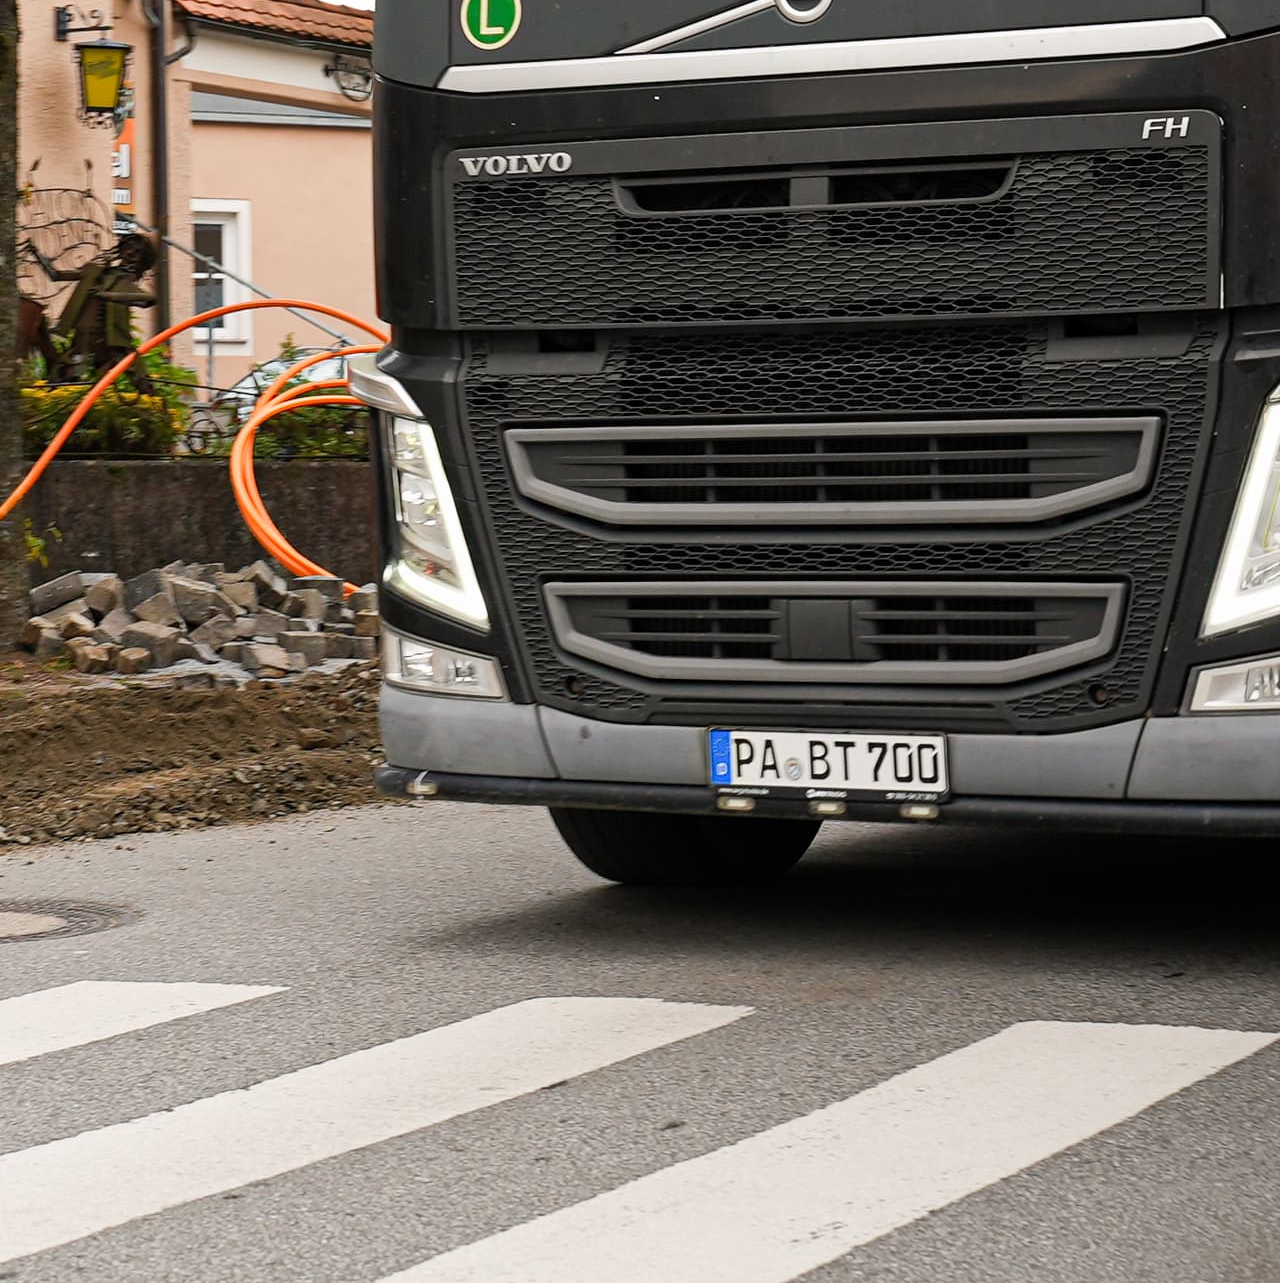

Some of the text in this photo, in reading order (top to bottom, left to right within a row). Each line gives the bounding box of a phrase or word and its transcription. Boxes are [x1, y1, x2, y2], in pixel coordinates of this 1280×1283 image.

[1142, 116, 1190, 139] FH
[459, 151, 573, 177] VOLVO
[733, 738, 939, 784] PA BT 700
